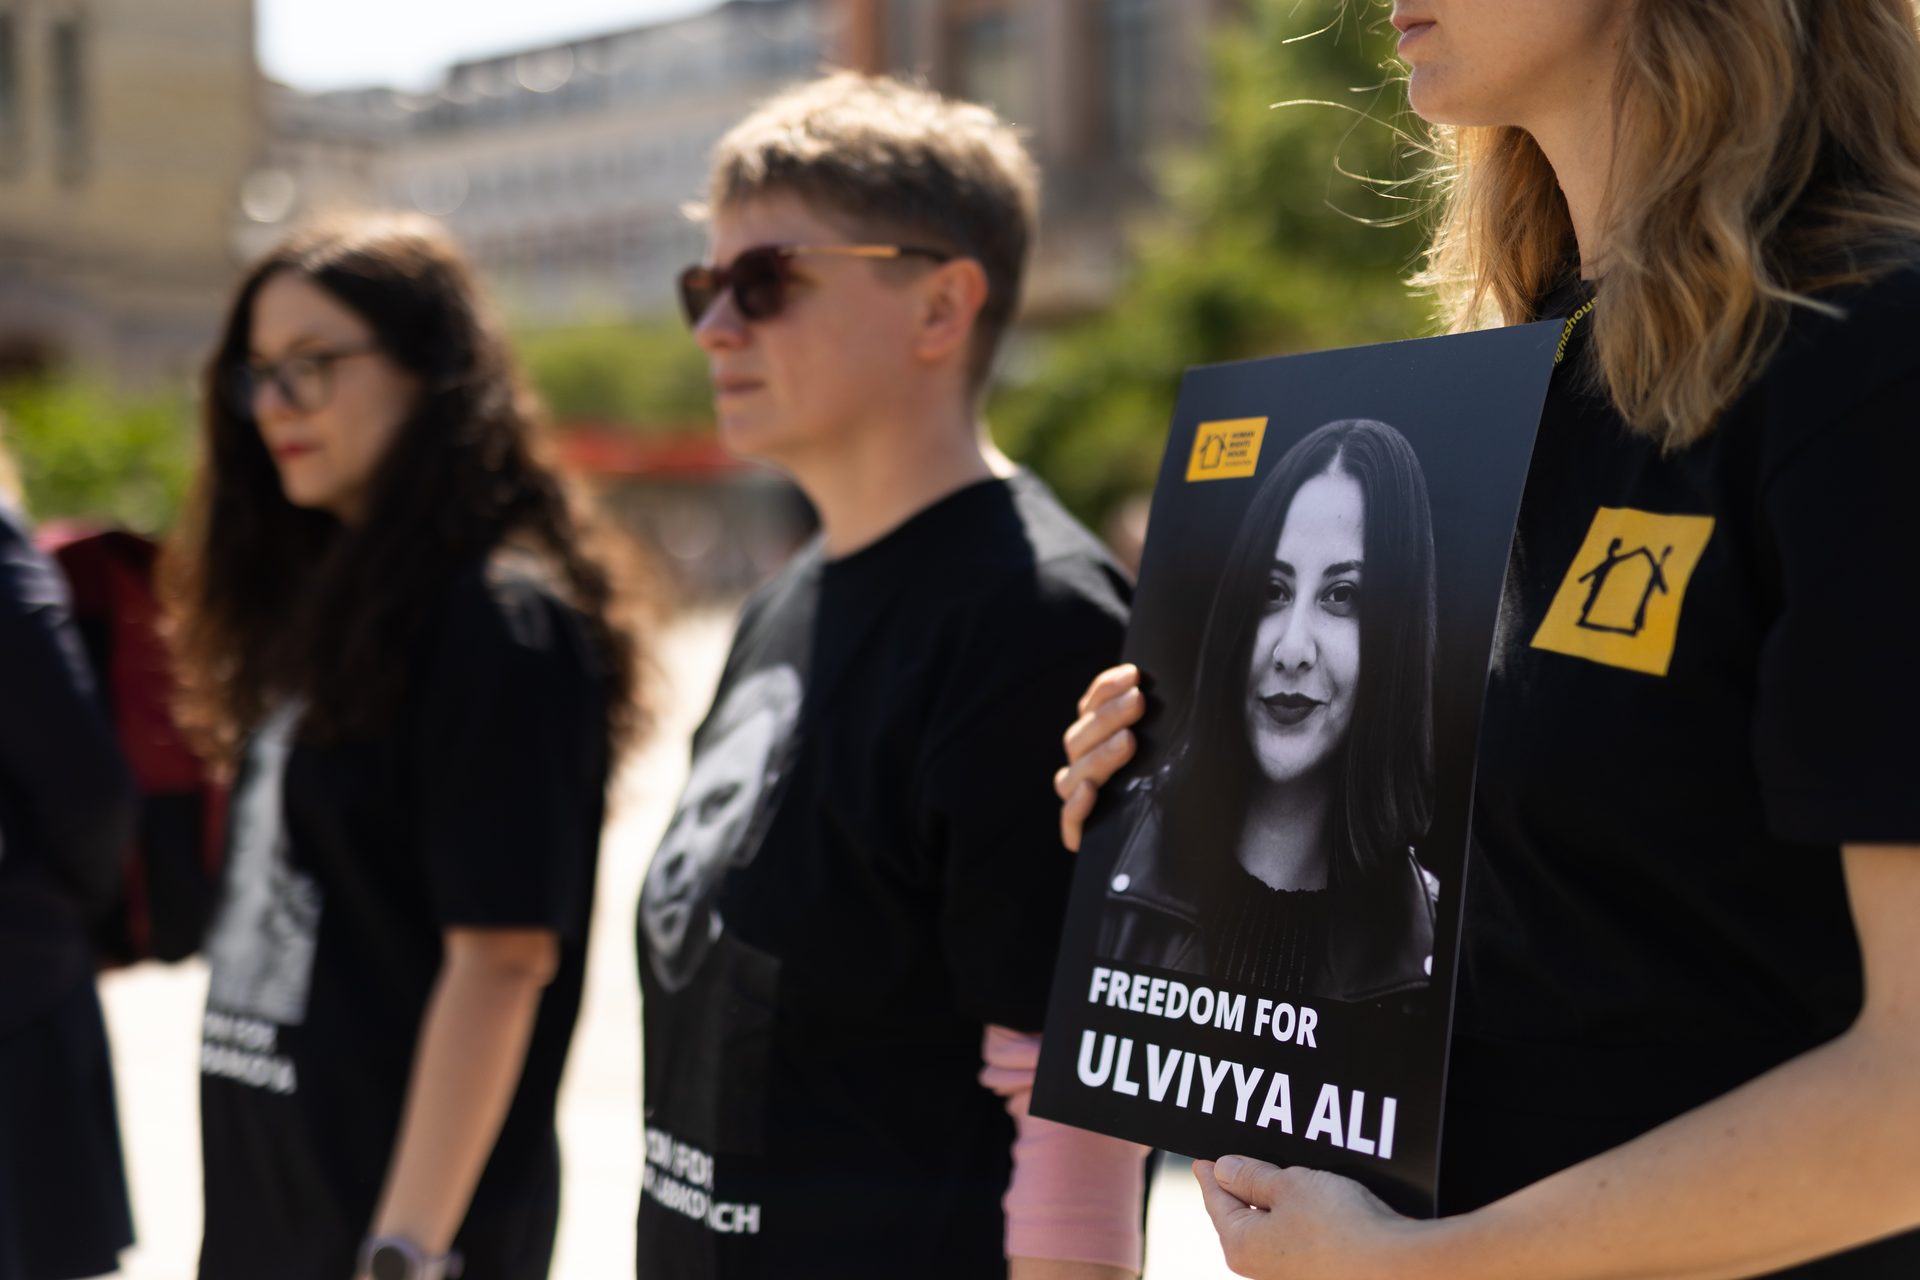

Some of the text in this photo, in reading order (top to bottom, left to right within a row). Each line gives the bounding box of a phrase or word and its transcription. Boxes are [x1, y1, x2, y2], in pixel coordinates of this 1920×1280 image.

[1088, 966, 1318, 1049] FREEDOM FOR
[1076, 1029, 1398, 1160] ULVIYYA ALI
